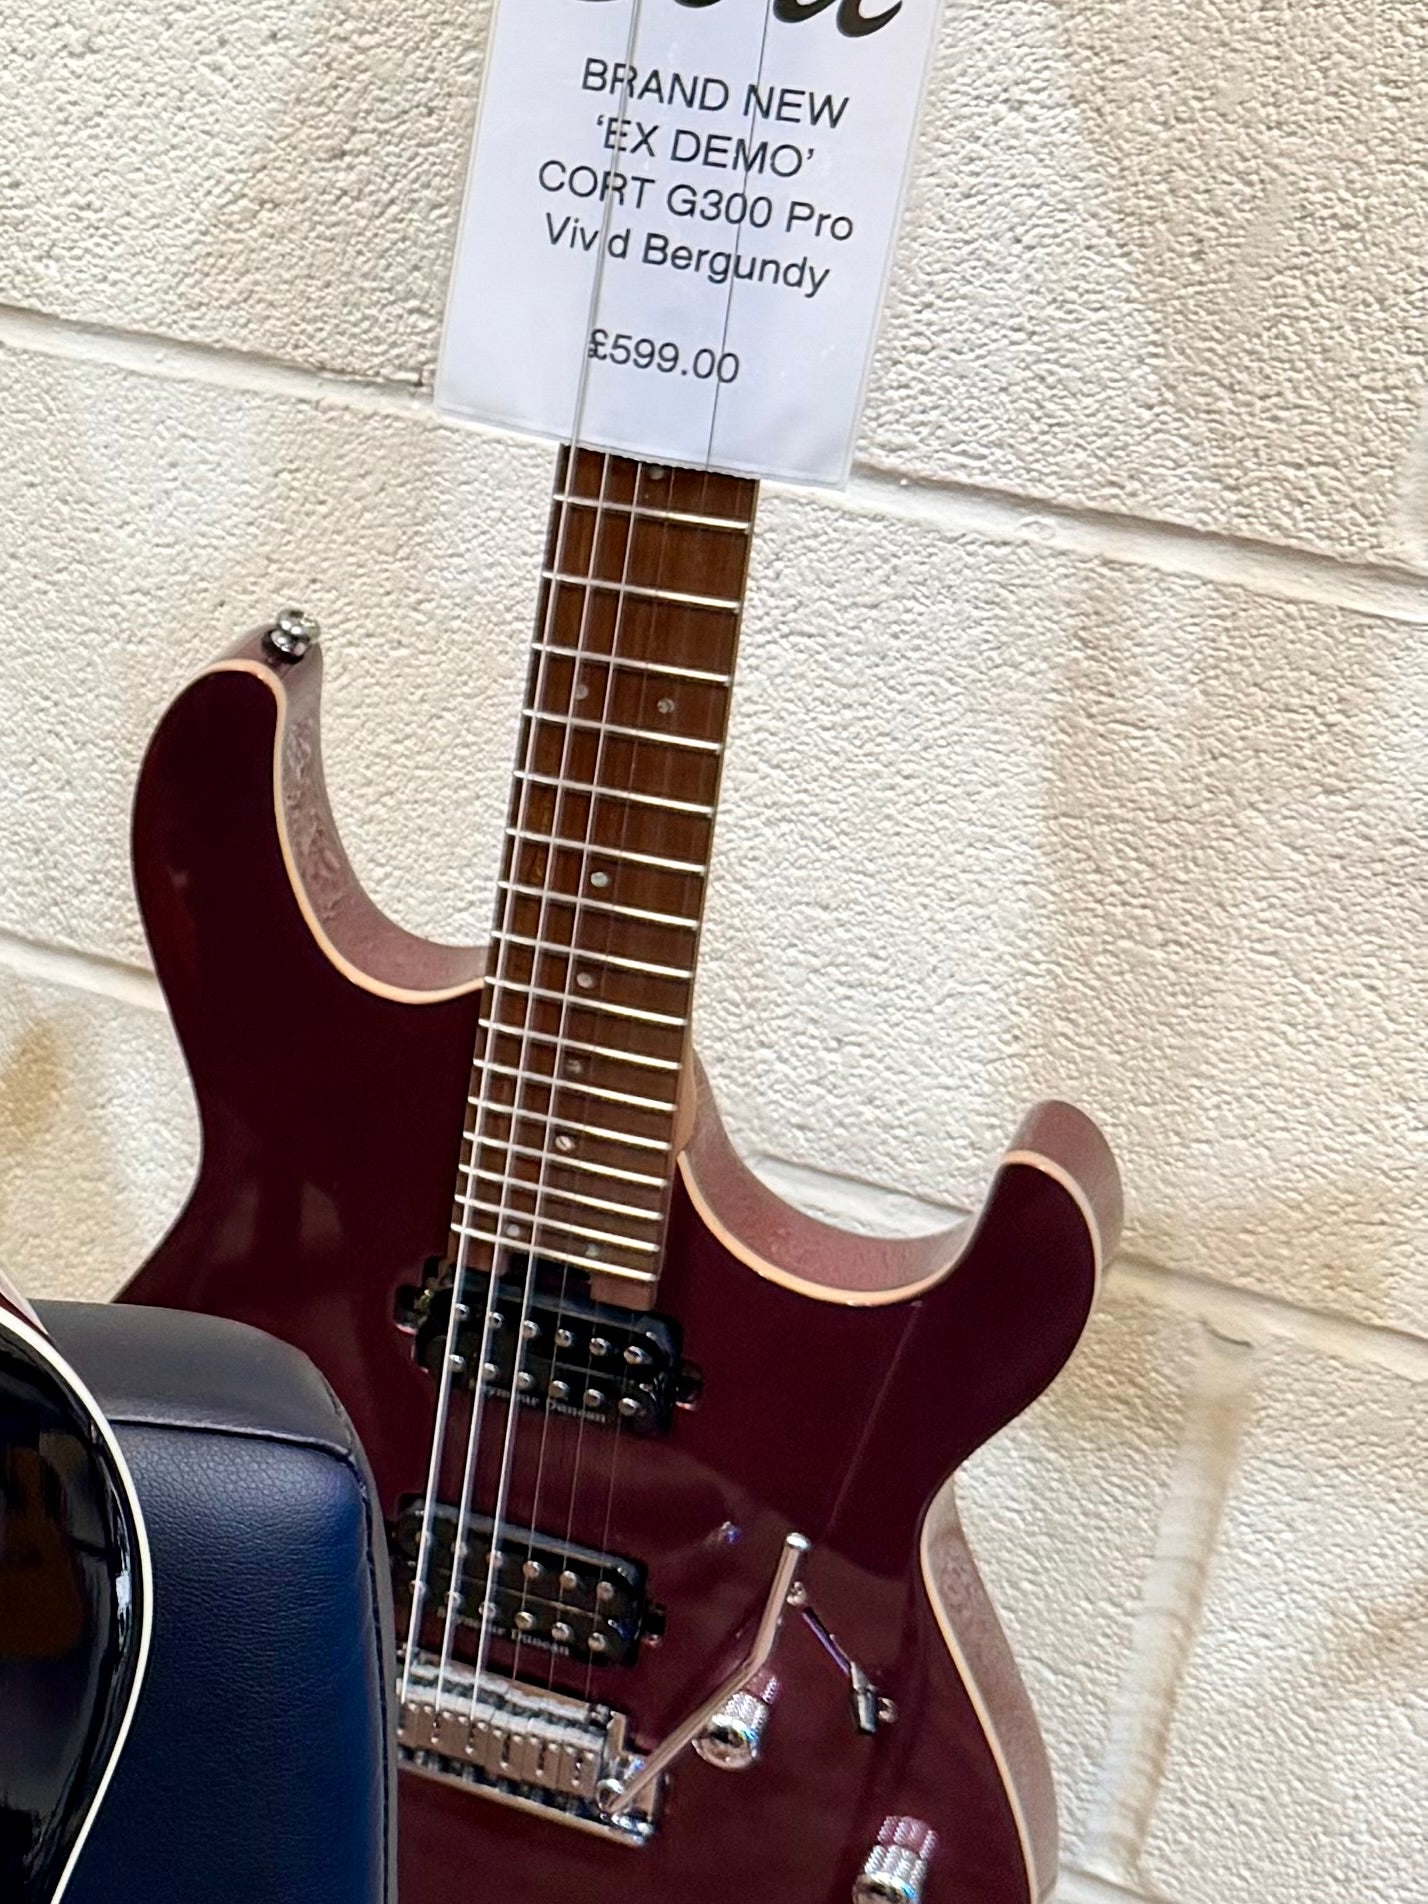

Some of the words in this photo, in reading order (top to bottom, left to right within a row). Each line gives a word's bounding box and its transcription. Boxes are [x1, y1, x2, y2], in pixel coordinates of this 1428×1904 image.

[581, 58, 729, 112] BRAND
[743, 84, 849, 130] NEW
[538, 160, 656, 210] CORT
[666, 184, 773, 228] G300
[787, 202, 854, 242] Pro
[545, 213, 632, 259] Vivd
[643, 233, 830, 298] Bergundy
[589, 330, 740, 385] £599.00
